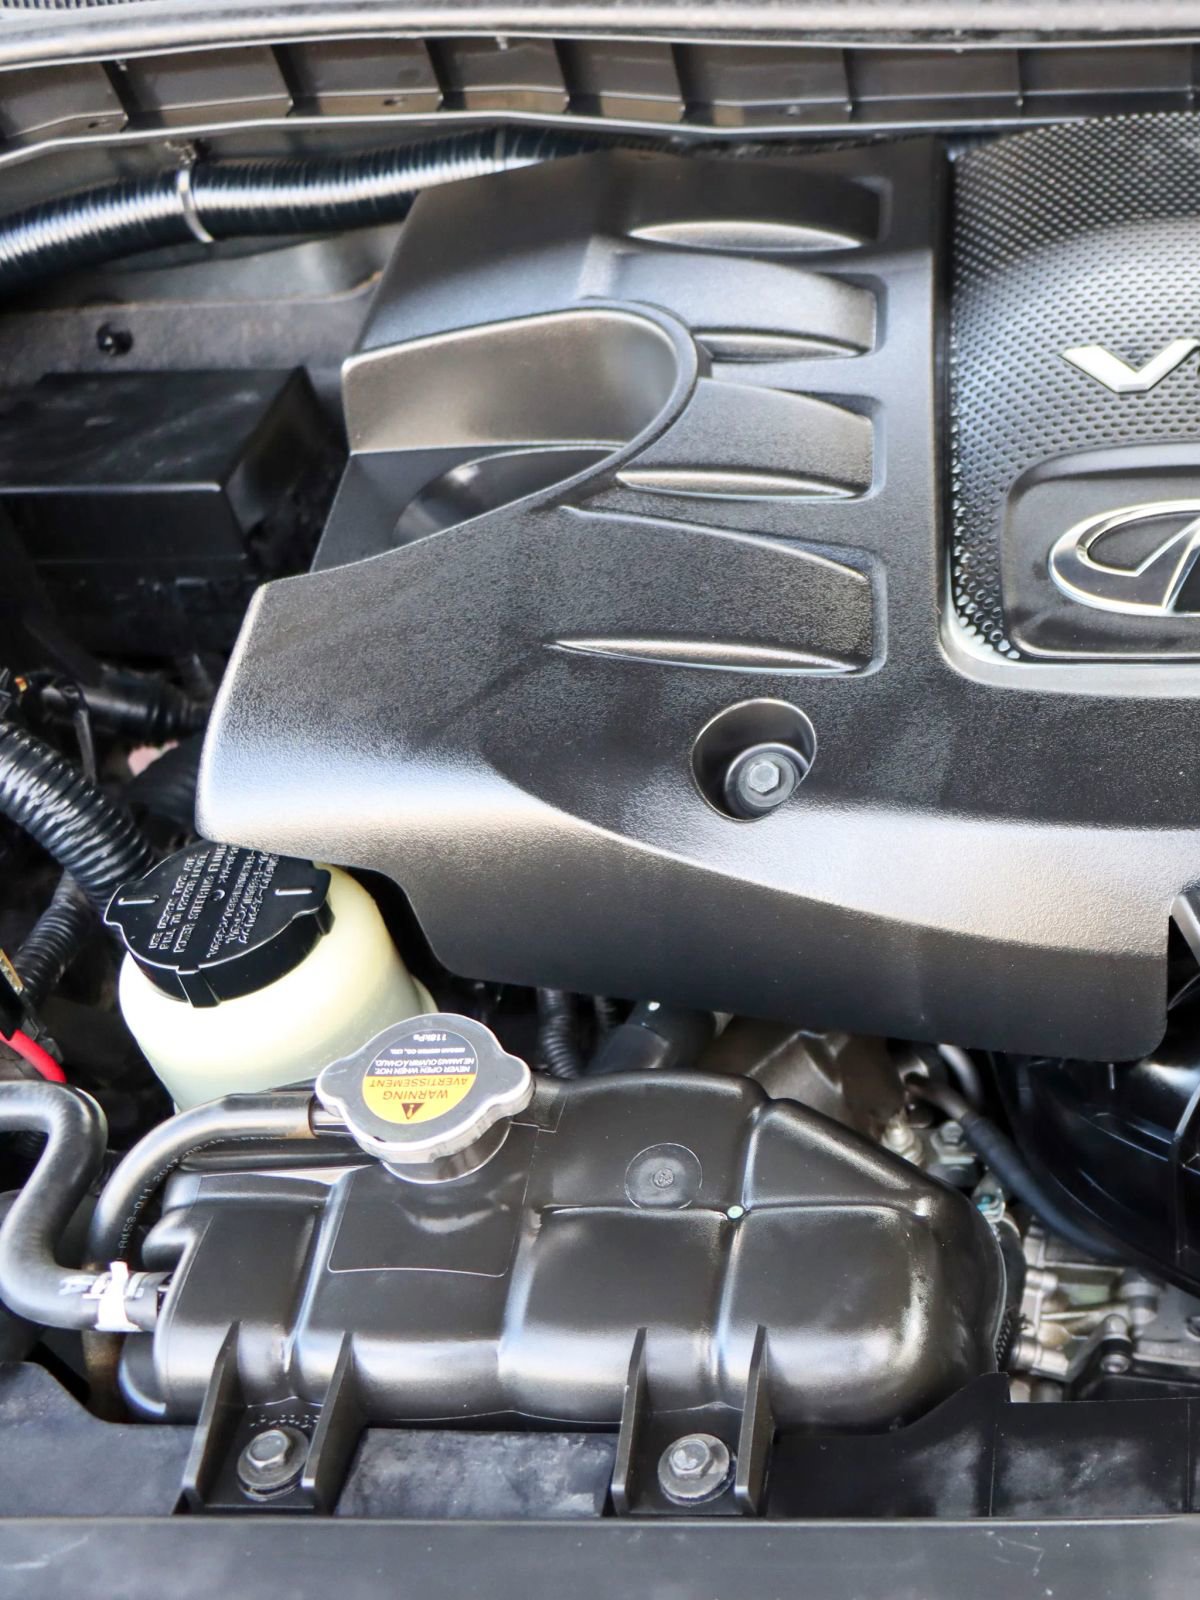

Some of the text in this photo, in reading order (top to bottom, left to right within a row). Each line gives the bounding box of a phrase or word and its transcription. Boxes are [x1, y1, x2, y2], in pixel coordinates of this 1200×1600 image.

[394, 1067, 419, 1075] WHEN
[368, 1078, 469, 1088] AVERTISSEMENT
[383, 1089, 449, 1101] WARNING
